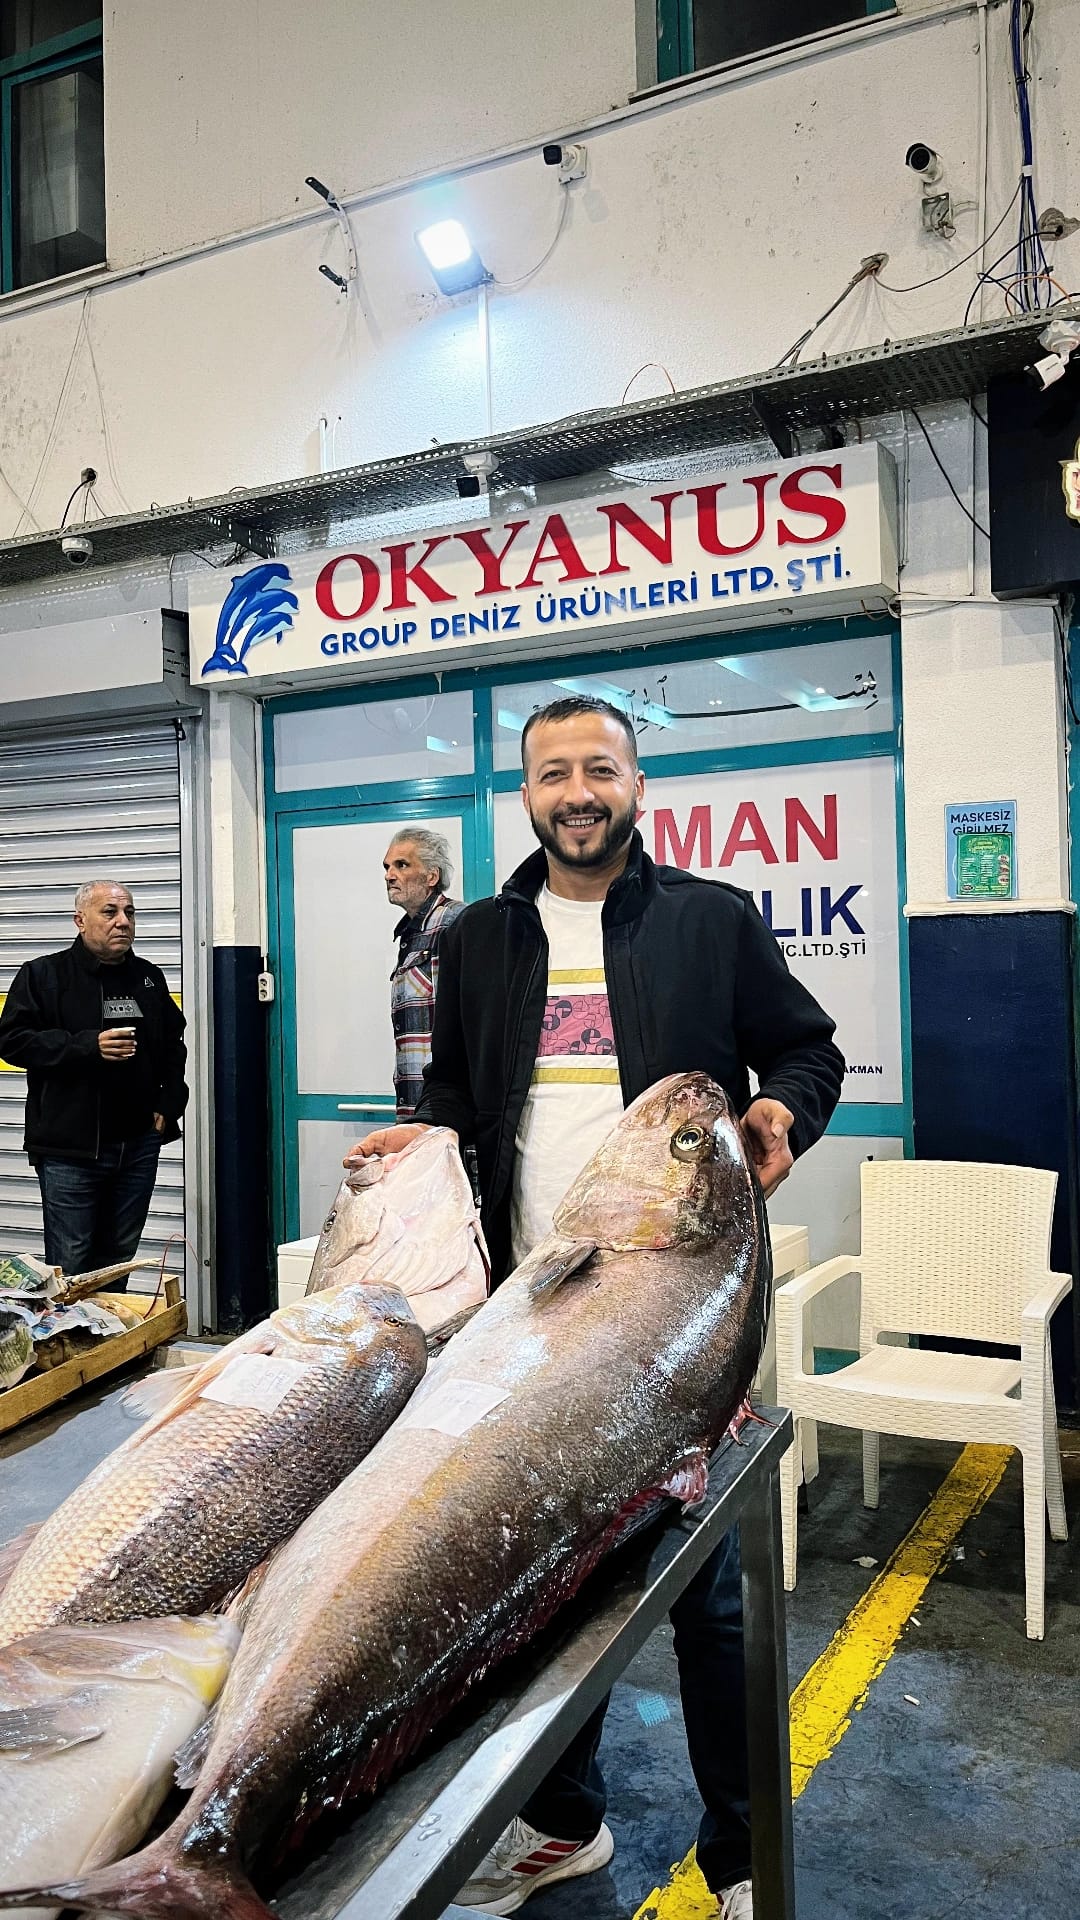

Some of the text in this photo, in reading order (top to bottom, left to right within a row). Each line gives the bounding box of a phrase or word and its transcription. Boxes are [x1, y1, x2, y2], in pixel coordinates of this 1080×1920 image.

[316, 464, 846, 620] OKYANUS
[321, 546, 851, 655] GROUP DENİZ ÜRÜNLERİ LTD. ŞTİ.
[635, 794, 838, 870] MAN
[951, 808, 1011, 823] MASKESİZ
